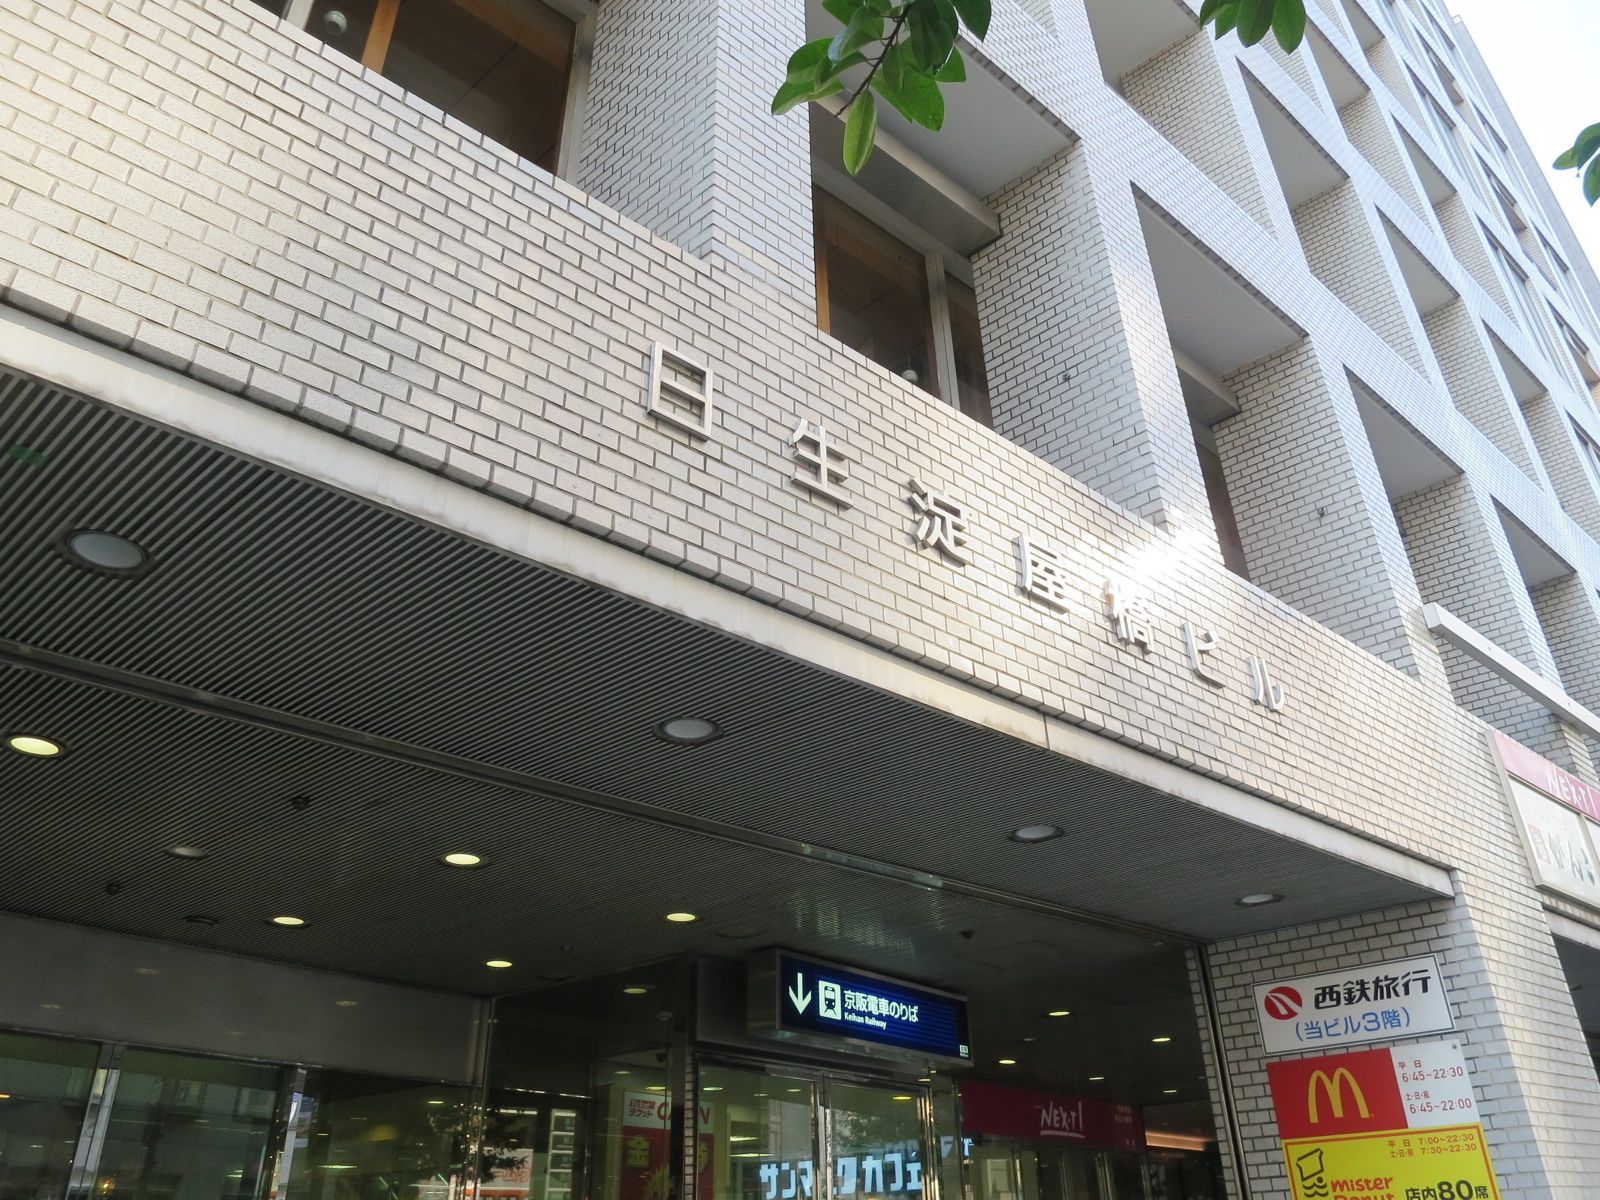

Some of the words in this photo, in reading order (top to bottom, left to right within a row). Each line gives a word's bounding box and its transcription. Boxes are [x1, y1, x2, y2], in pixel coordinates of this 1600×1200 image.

[844, 990, 918, 1022] 京阪電車のりば
[1314, 969, 1431, 1010] 西鉄旅行
[844, 1012, 864, 1023] Keihan
[865, 1016, 887, 1030] Railway
[1296, 1006, 1411, 1041] (当ビル3階)
[760, 1152, 922, 1199] サンマクカフェ
[1405, 1179, 1489, 1200] 店内80席
